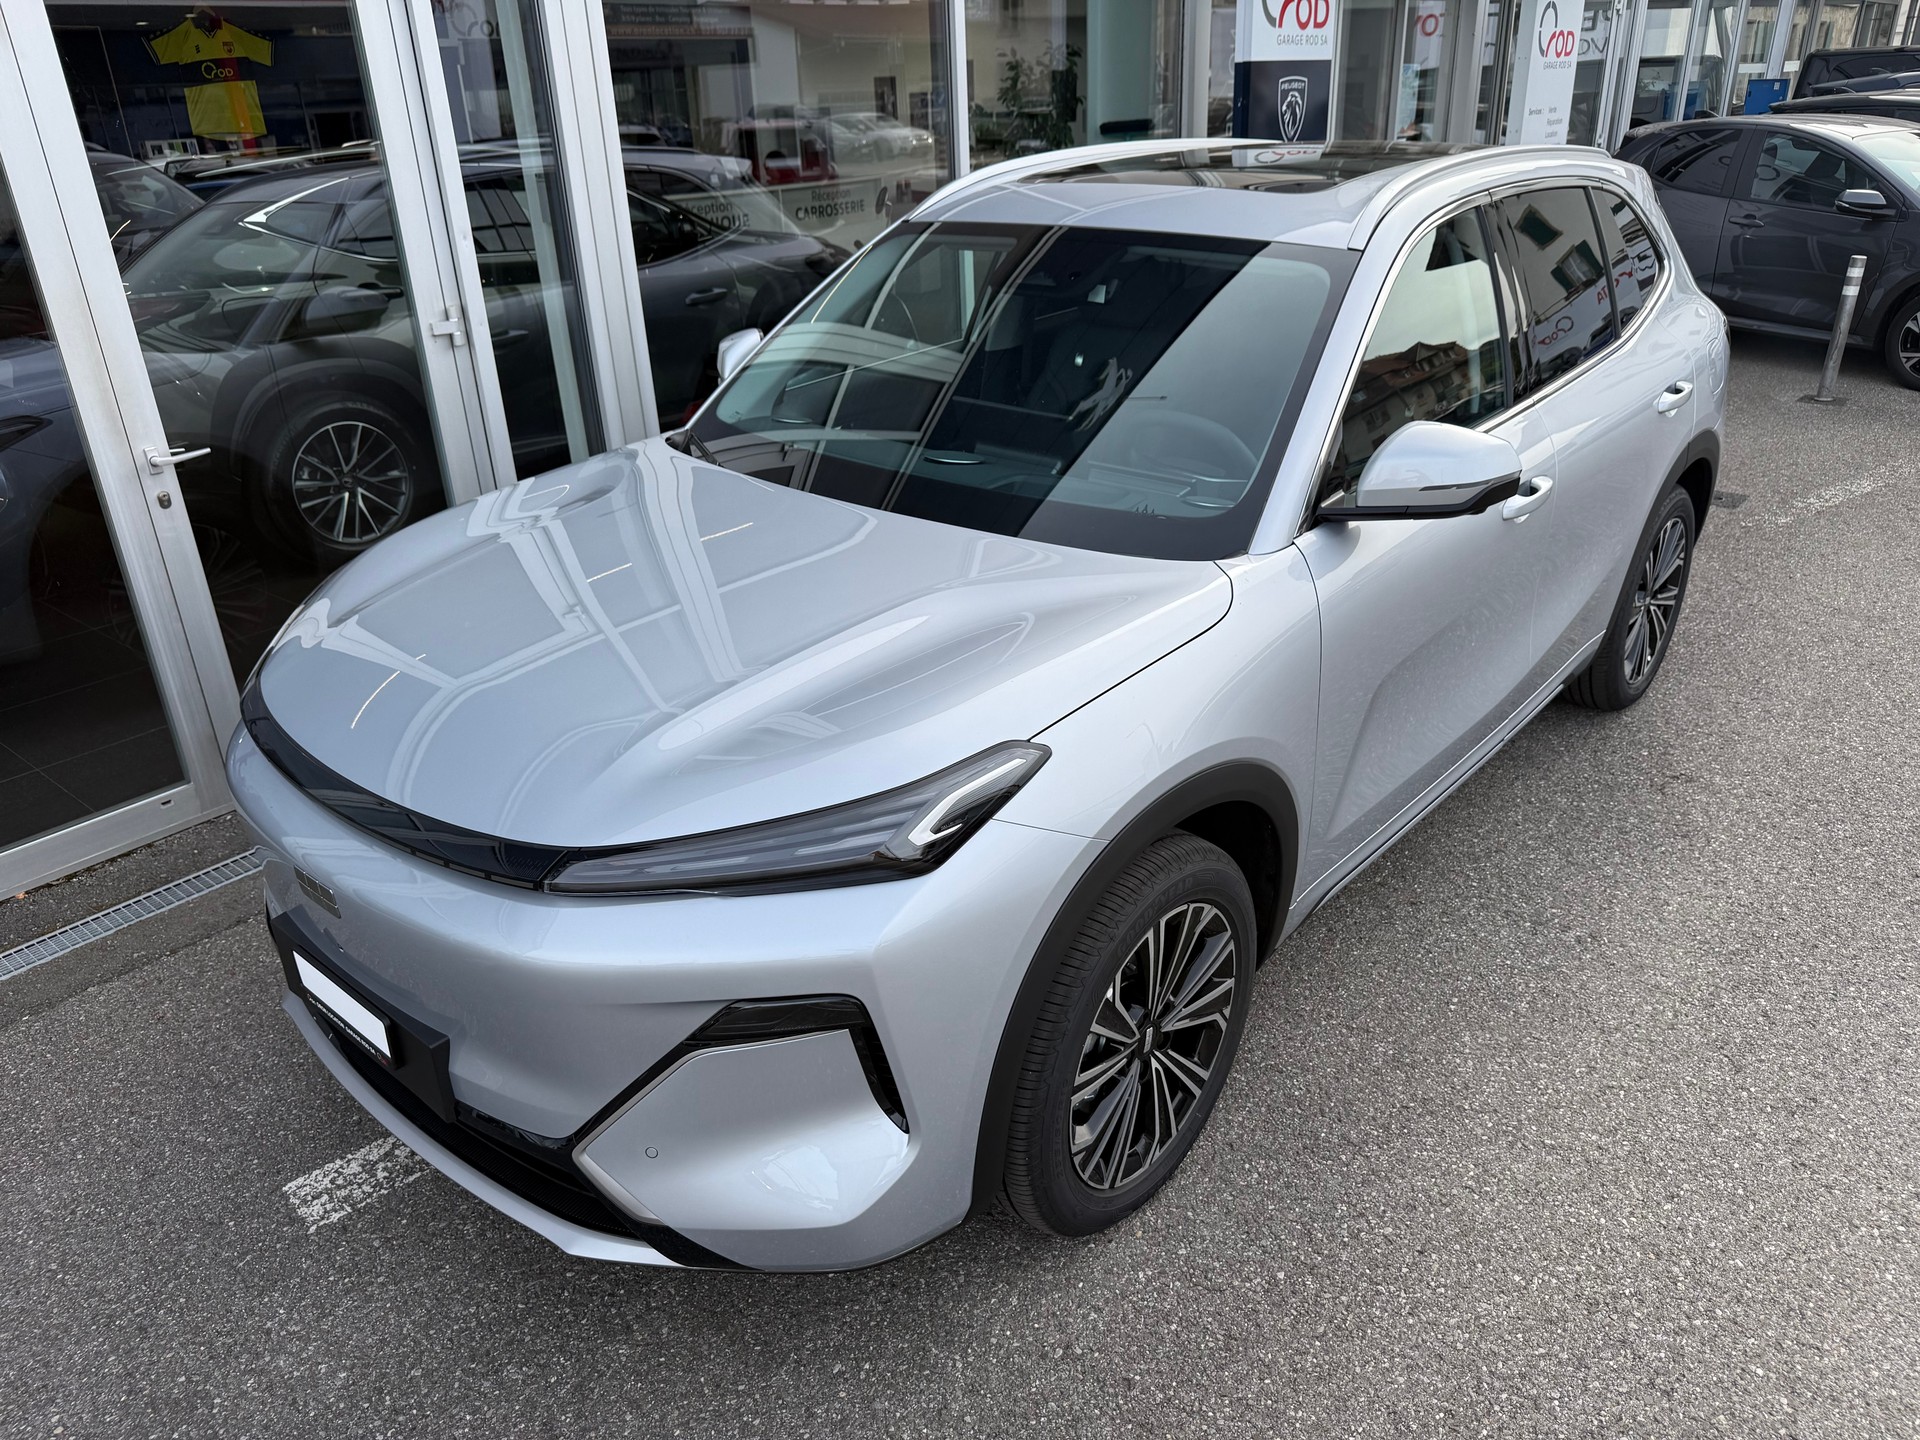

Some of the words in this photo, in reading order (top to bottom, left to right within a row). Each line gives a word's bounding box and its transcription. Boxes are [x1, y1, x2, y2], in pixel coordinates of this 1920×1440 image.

[1276, 34, 1304, 46] GARAGE
[1305, 34, 1319, 46] ROD
[1320, 34, 1328, 46] SA
[1280, 82, 1305, 91] PEUGEOT
[811, 188, 852, 203] Réception
[795, 198, 865, 221] CARROSSERIE
